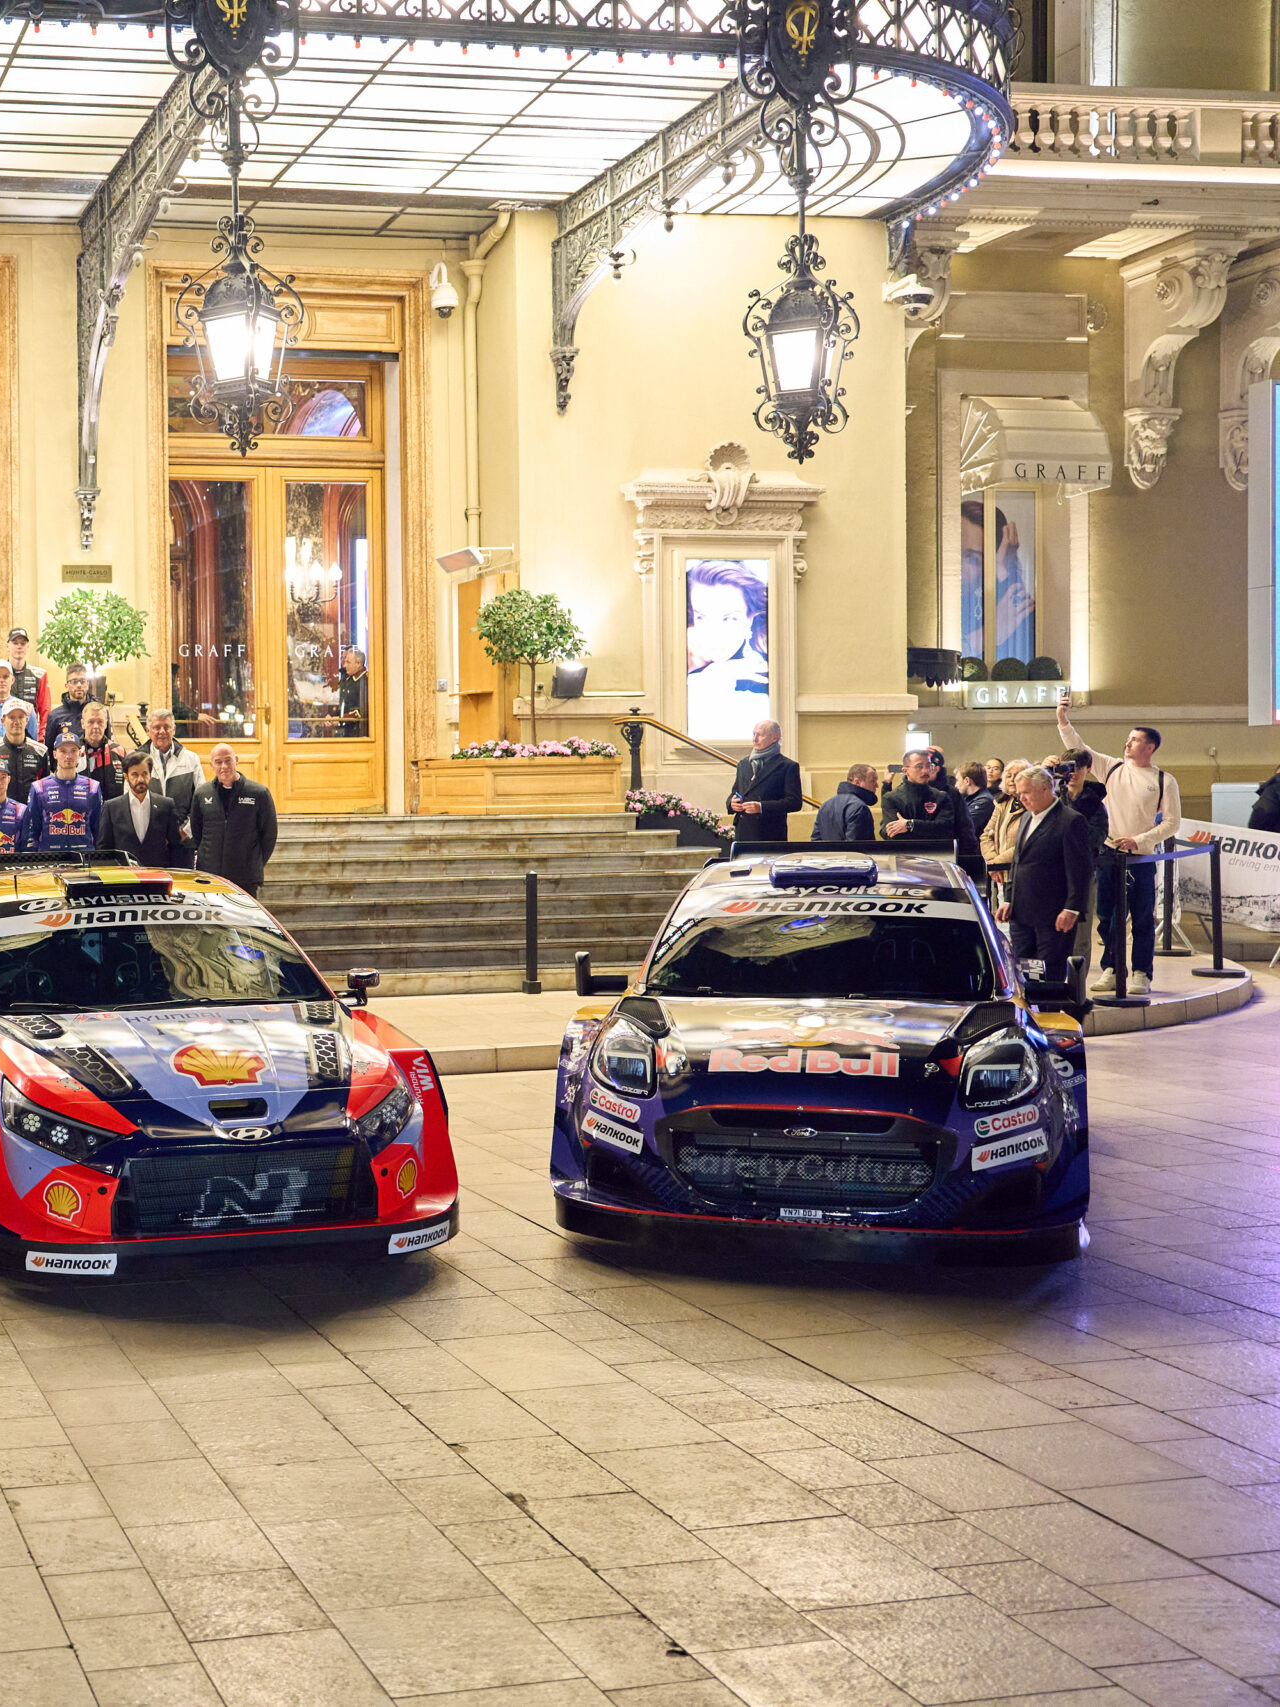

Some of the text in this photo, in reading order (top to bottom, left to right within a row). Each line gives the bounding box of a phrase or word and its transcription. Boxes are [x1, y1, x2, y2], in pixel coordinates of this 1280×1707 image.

[1014, 462, 1107, 481] GRAFF
[178, 643, 247, 658] GRAFF
[294, 644, 364, 658] GRAFF
[976, 686, 1069, 705] GRAFF
[49, 824, 86, 835] Red Bull
[1210, 835, 1280, 861] anko
[1228, 857, 1261, 871] driving
[69, 894, 176, 907] HYUNDAI
[125, 1011, 222, 1023] HYUNDAI
[708, 1048, 900, 1078] Red Bull
[409, 1071, 424, 1104] HYUNDAI
[598, 1095, 639, 1121] Castrol
[991, 1107, 1037, 1132] Castrol
[790, 1128, 813, 1137] Ford
[677, 1145, 934, 1188] SafetyCulture
[783, 1209, 800, 1217] YN71
